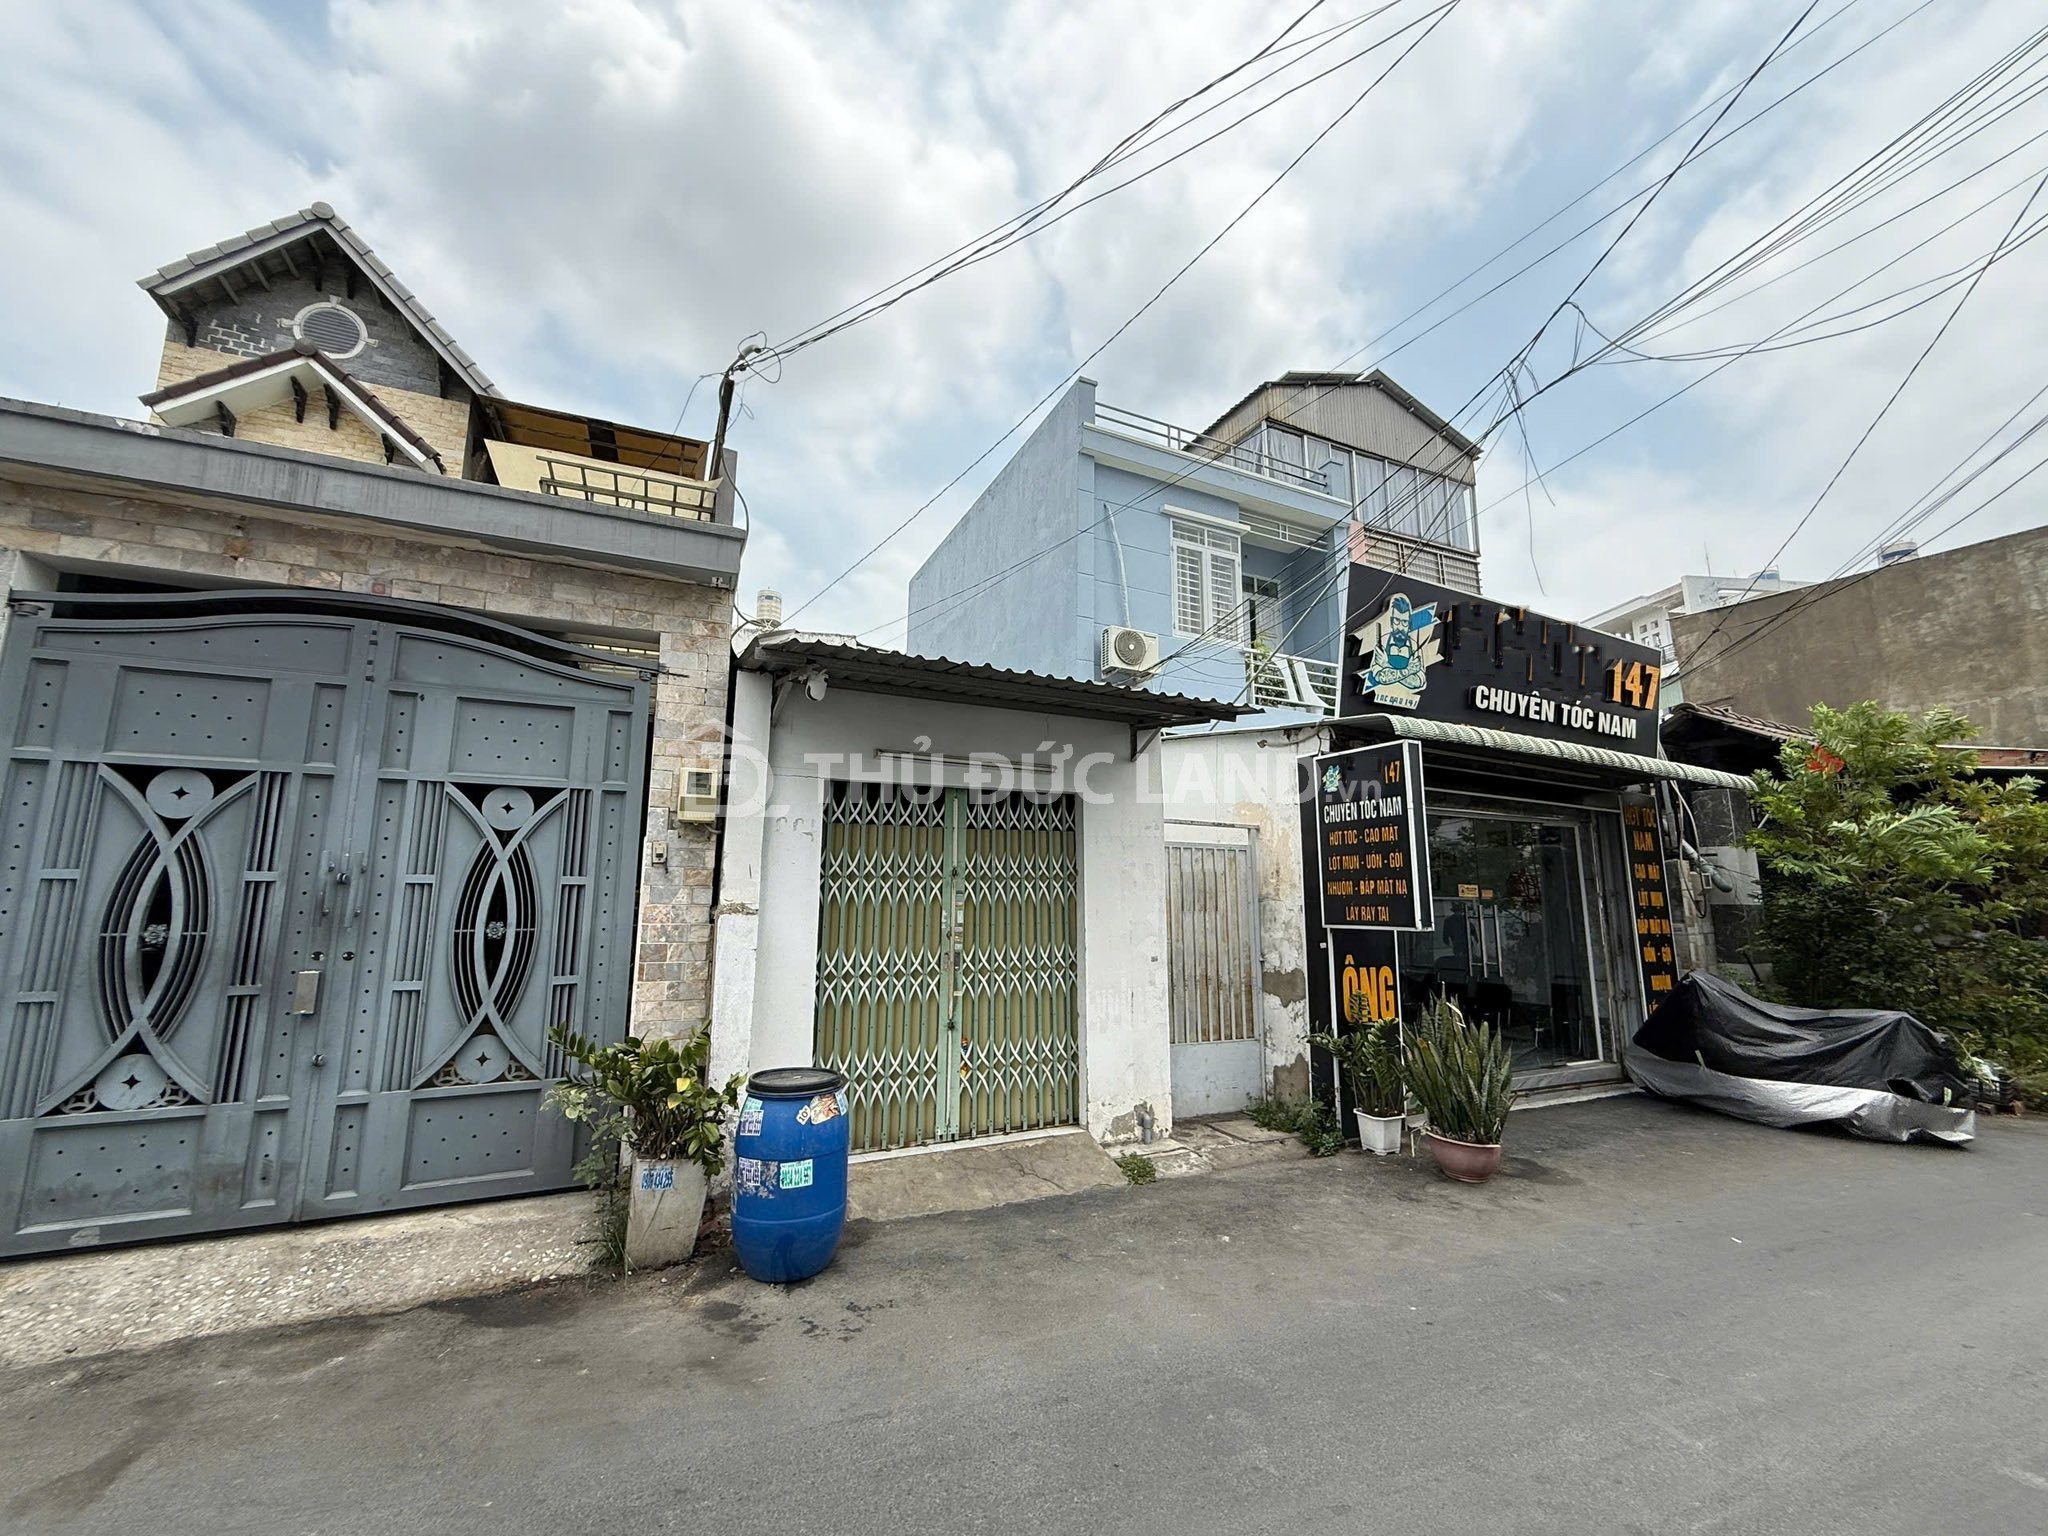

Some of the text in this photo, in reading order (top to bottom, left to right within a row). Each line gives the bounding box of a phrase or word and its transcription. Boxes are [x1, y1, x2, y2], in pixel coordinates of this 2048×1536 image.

[1612, 657, 1660, 711] 147
[1475, 684, 1637, 740] CHUYÊN TÓC NAM
[1384, 760, 1401, 784] 147
[1324, 795, 1403, 824] CHUYÊN TÓC NAM
[1633, 830, 1654, 851] NAM
[1377, 905, 1390, 922] TAI
[1342, 954, 1397, 1024] ÔNG
